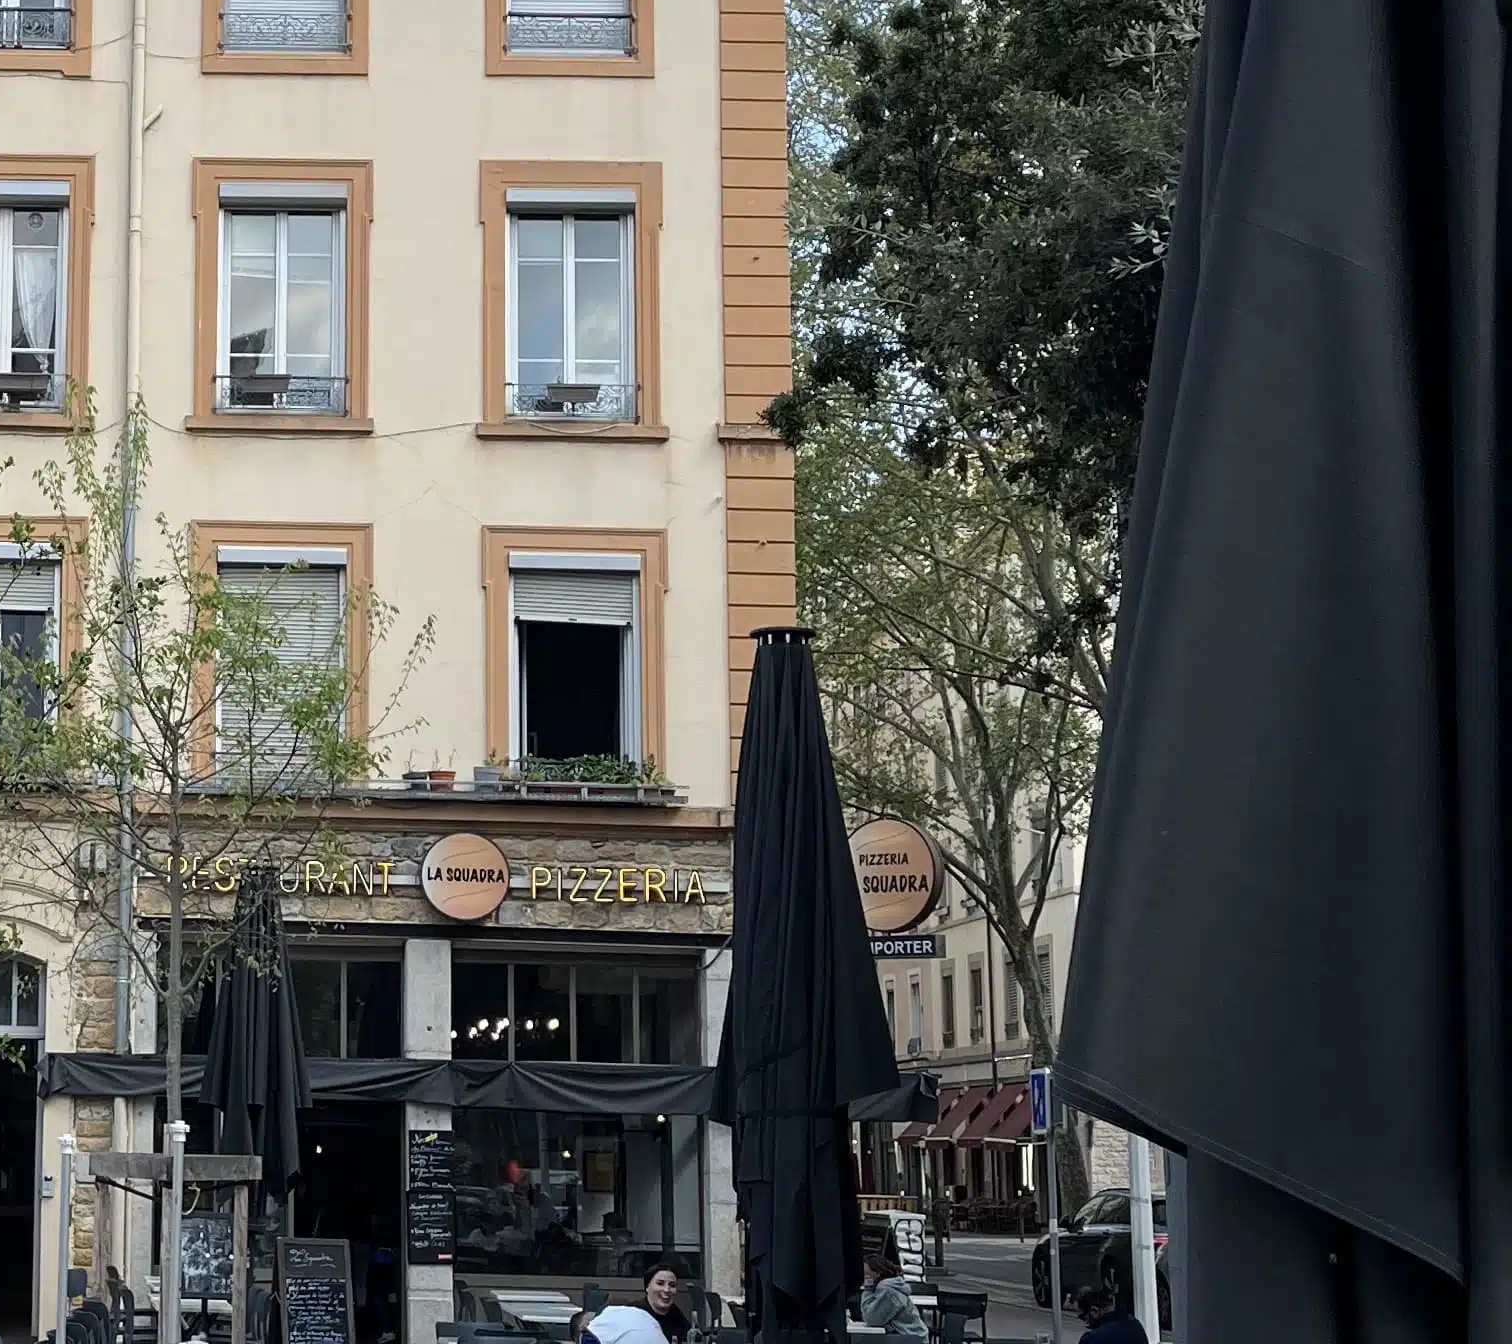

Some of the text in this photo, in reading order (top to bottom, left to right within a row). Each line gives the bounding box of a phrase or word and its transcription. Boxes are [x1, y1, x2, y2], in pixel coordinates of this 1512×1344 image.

[859, 853, 909, 866] PIZZERIA
[167, 856, 397, 896] RESURANT
[427, 867, 505, 884] LA SQUADRA
[531, 866, 706, 904] PIZZERIA
[863, 874, 929, 893] SQUADRA
